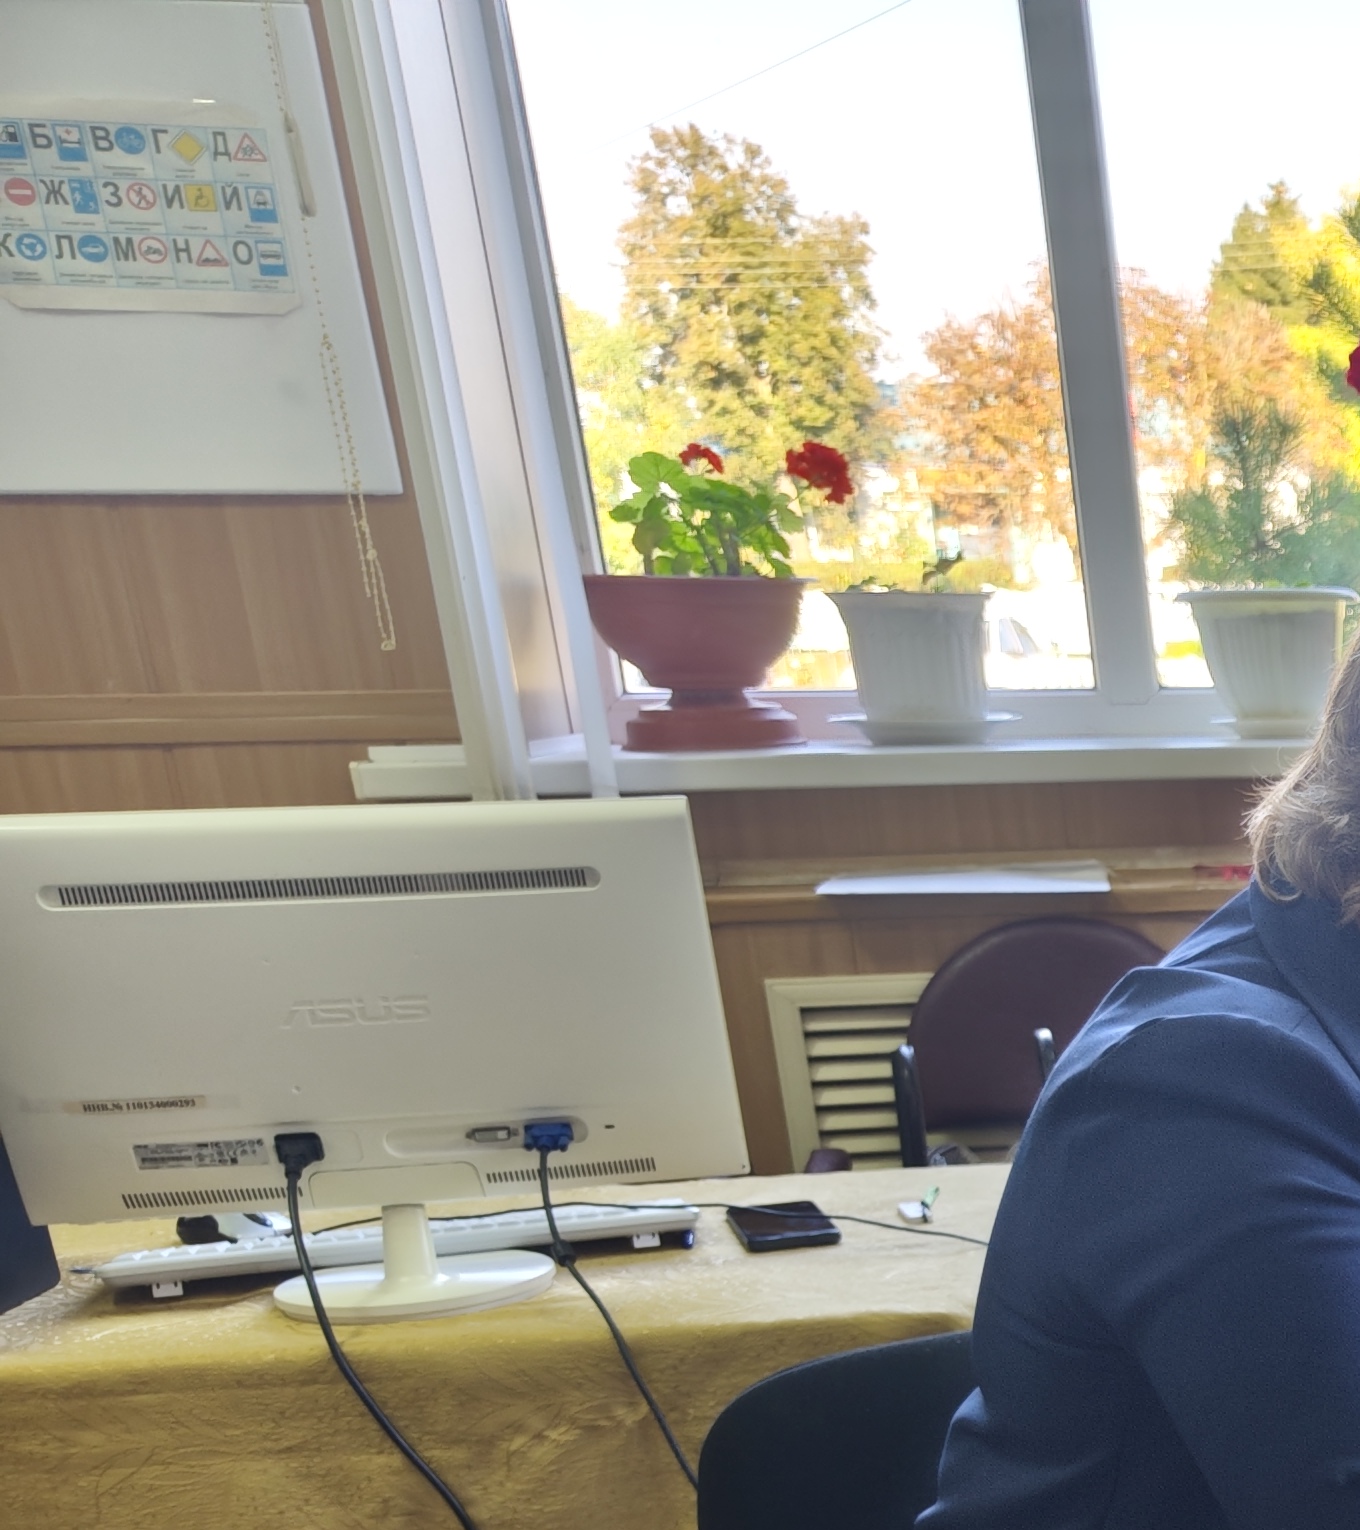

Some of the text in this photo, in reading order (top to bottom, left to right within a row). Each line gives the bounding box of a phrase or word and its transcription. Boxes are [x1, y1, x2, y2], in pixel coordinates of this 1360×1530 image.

[29, 124, 232, 160] Б В Г Д
[41, 179, 243, 212] Ж З И Й
[55, 234, 77, 260] Л
[114, 238, 137, 263] М
[174, 239, 194, 264] Н
[232, 241, 253, 266] О
[281, 994, 430, 1029] ASUS
